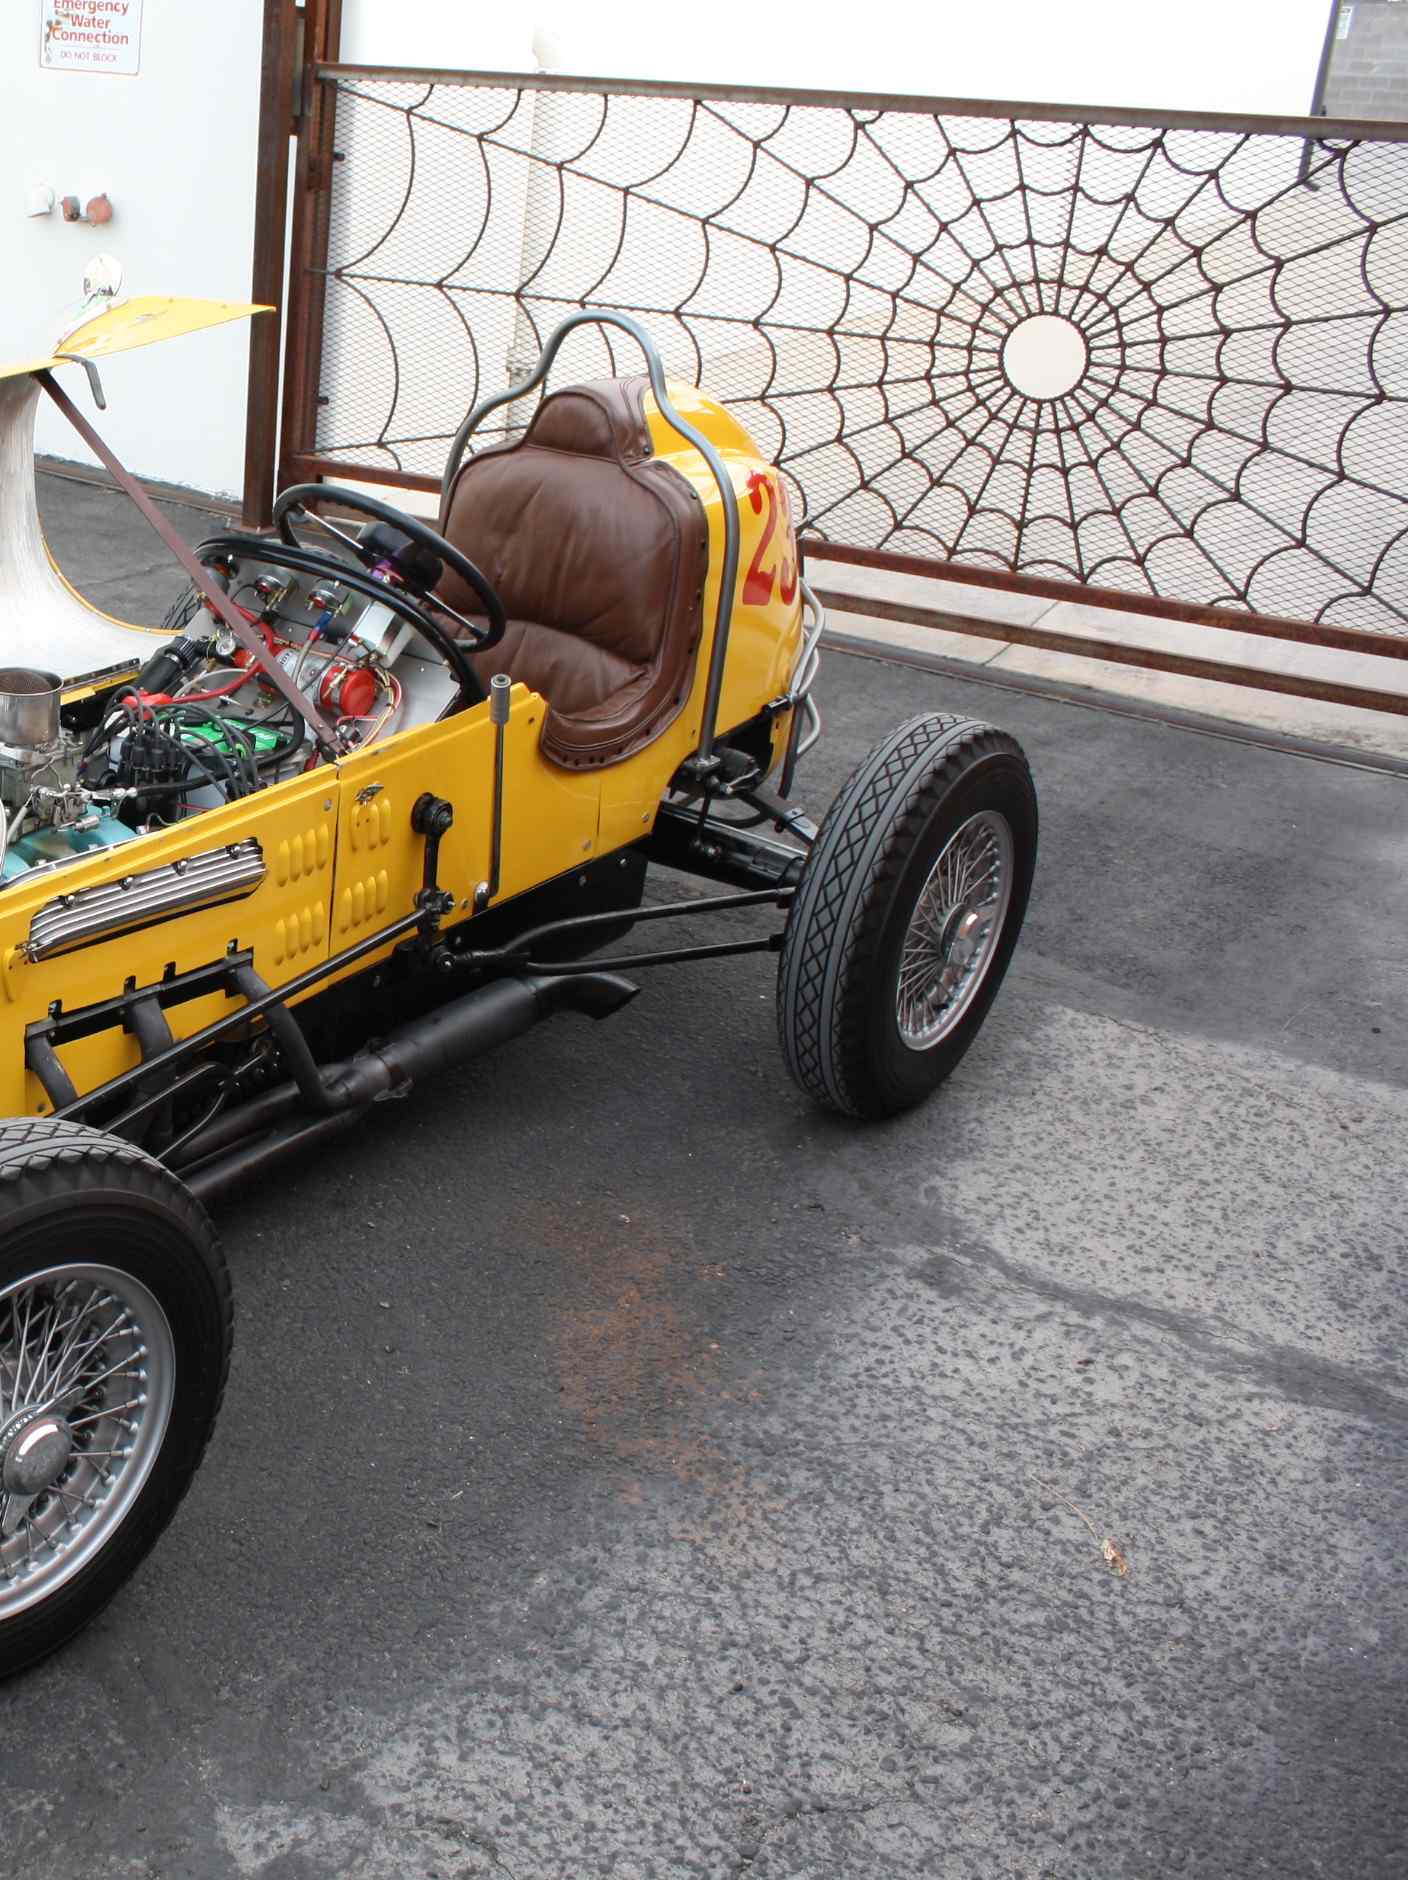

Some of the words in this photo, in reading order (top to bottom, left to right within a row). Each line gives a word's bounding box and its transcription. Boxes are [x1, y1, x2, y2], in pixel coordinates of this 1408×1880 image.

[53, 0, 129, 16] Emergency
[71, 14, 112, 29] Water
[52, 30, 129, 45] Connection
